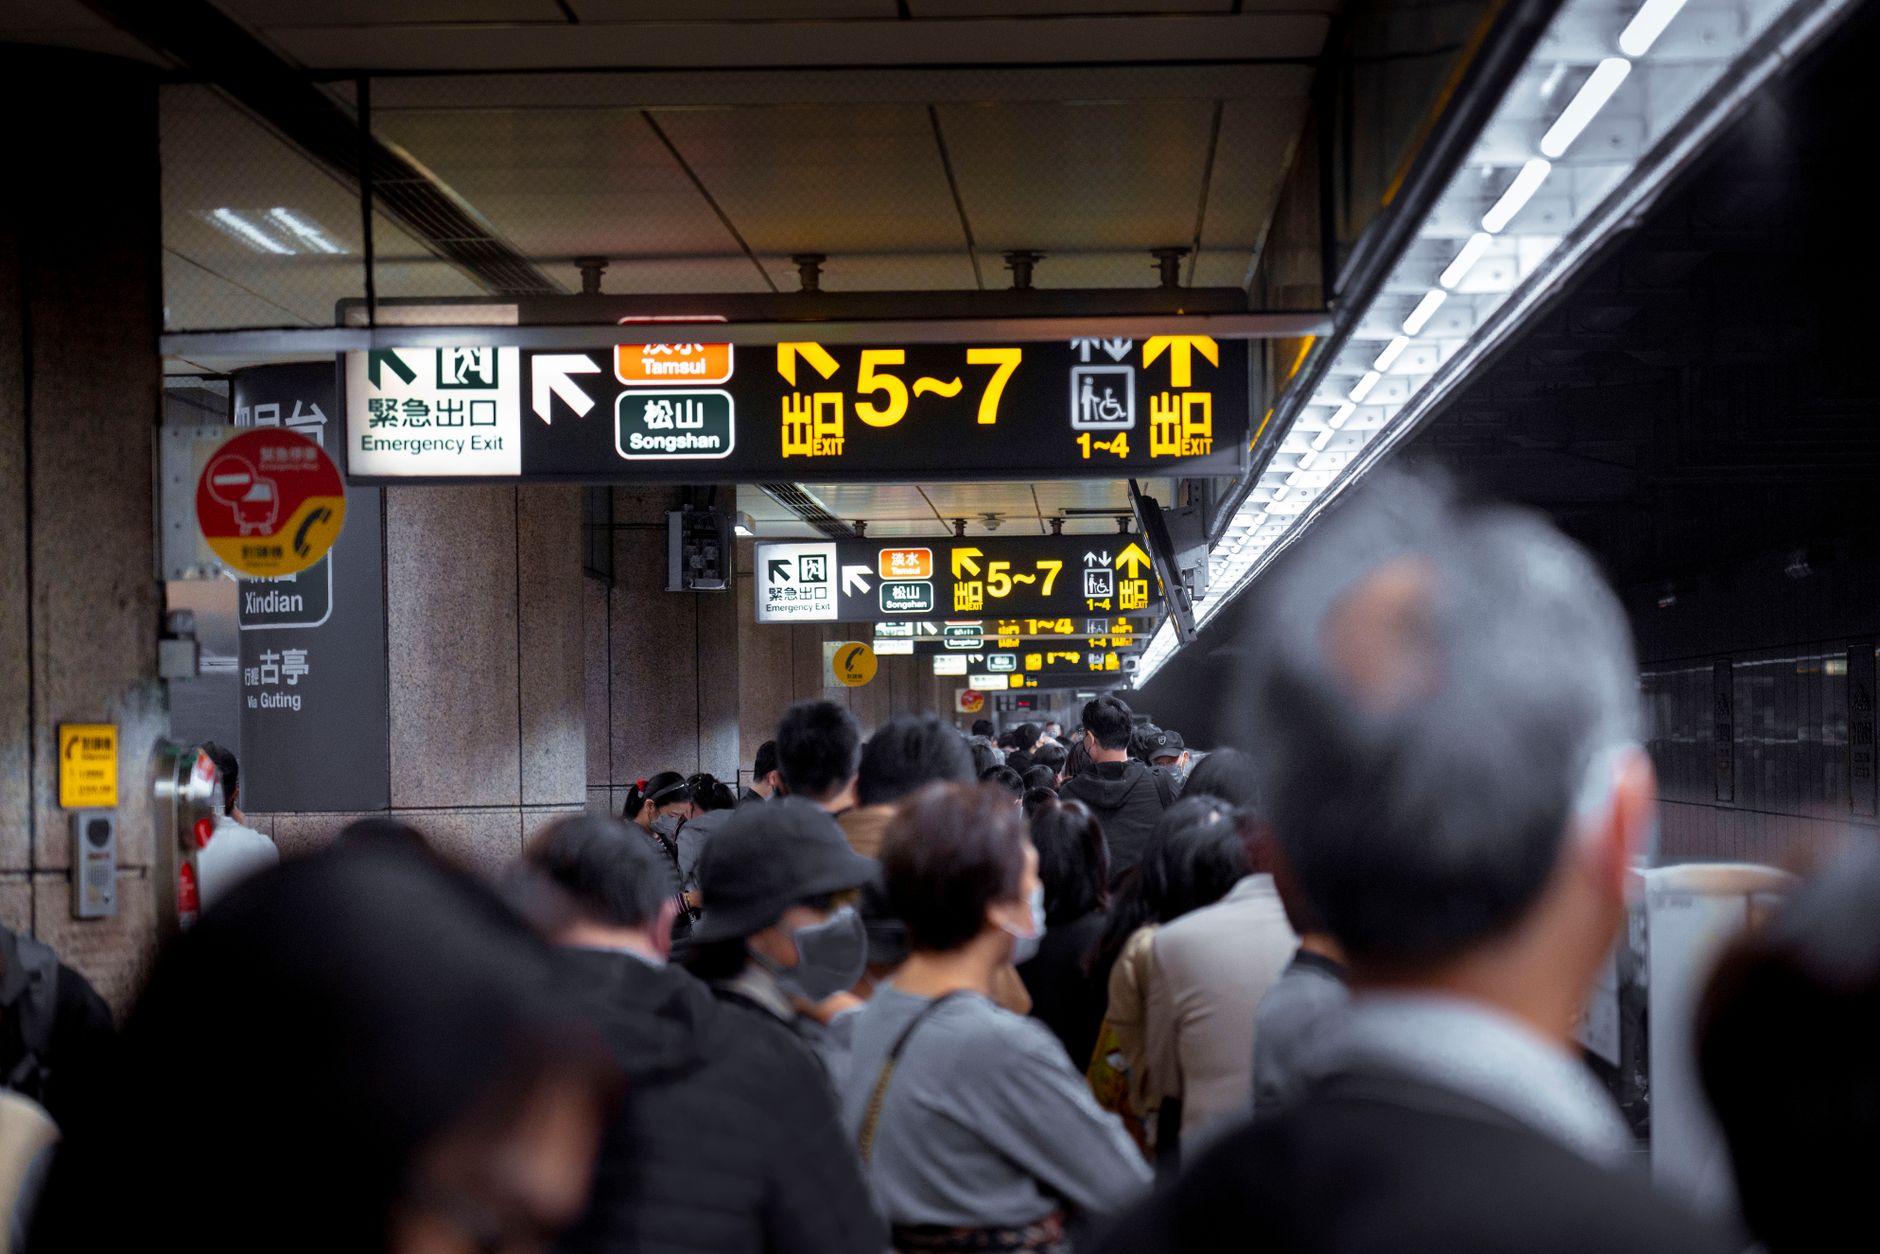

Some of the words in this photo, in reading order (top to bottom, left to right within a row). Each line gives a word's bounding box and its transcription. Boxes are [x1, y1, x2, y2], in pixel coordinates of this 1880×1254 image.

[641, 358, 706, 375] Tamsui
[367, 397, 497, 429] 緊急出口
[643, 399, 704, 430] 松山
[782, 392, 845, 458] 出口
[1150, 391, 1212, 458] 出口
[361, 434, 465, 455] Emergency
[471, 434, 504, 451] Exit
[630, 432, 720, 452] Songshan
[813, 437, 845, 456] EXIT
[1181, 438, 1213, 456] EXIT
[245, 590, 303, 614] Xindian
[768, 586, 828, 602] 緊急出口
[892, 585, 920, 600] 松山
[954, 581, 983, 611] 出口
[1119, 579, 1149, 610] 出口
[766, 602, 813, 614] Emergency
[815, 602, 831, 611] Exit
[886, 599, 928, 610] Songshan
[260, 691, 301, 711] Guting
